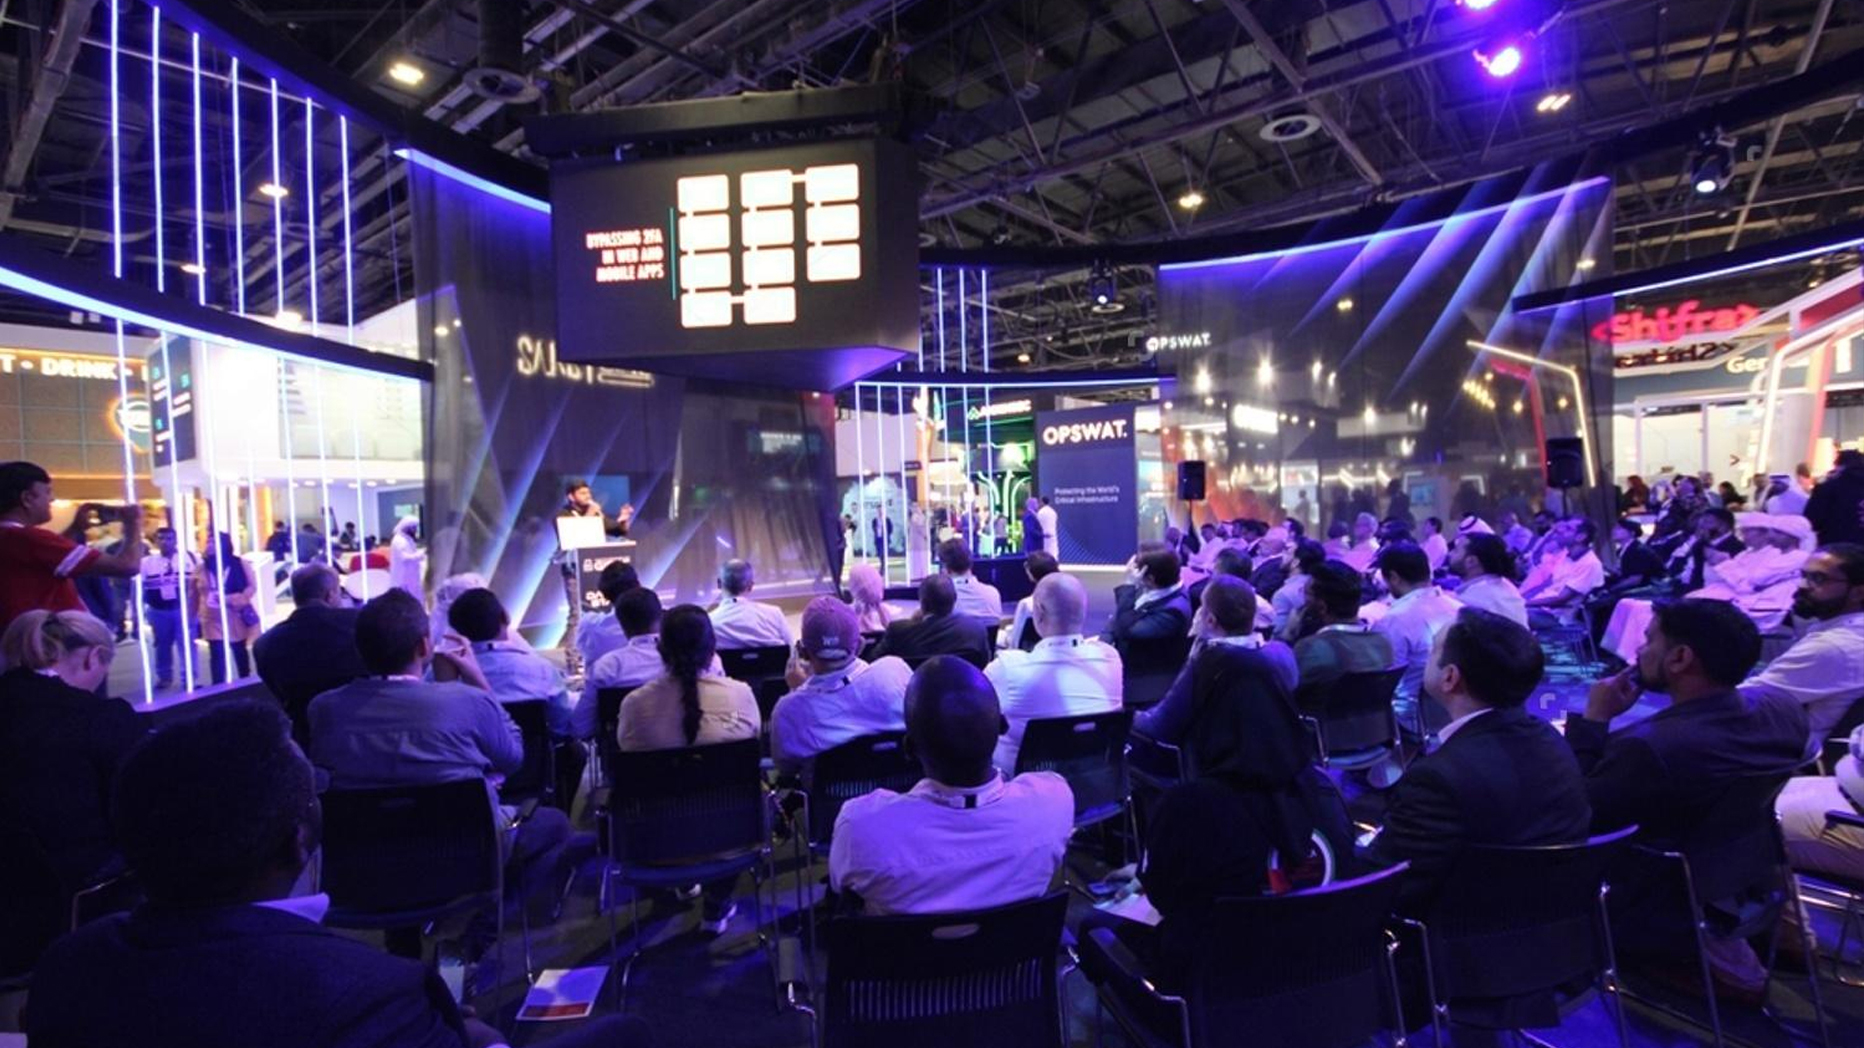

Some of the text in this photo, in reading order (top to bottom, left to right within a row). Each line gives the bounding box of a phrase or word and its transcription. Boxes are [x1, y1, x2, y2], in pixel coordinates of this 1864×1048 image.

[601, 249, 616, 265] IN
[616, 247, 639, 264] WEB
[595, 262, 665, 283] MOBILE APPS
[40, 357, 119, 381] DRINK
[1043, 419, 1128, 446] OPSWAT.
[1054, 487, 1085, 496] Protecting
[1086, 486, 1096, 494] the
[1054, 495, 1119, 504] Critical Infrastructure
